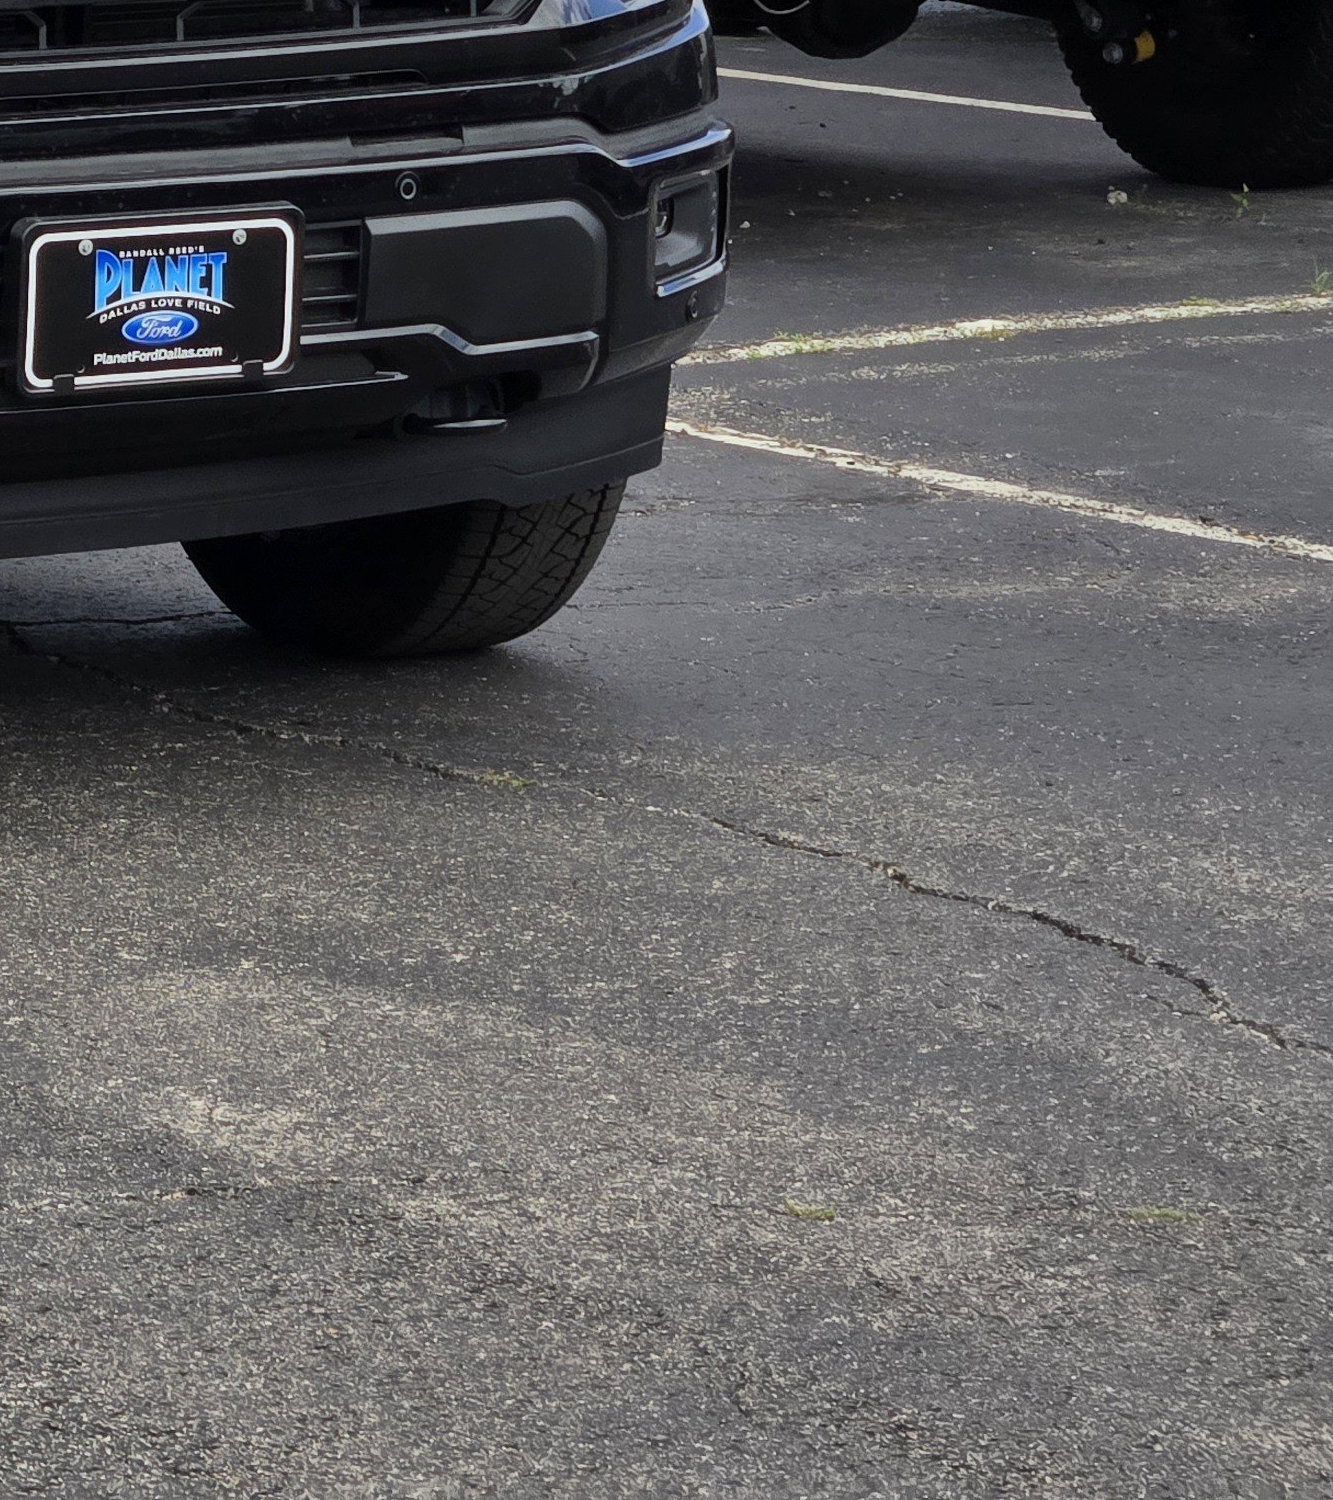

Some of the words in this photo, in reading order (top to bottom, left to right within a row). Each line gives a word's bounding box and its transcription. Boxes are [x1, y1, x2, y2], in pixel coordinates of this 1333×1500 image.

[95, 249, 228, 312] PLANET
[99, 301, 146, 324] DALLAS
[151, 298, 183, 308] LOVE
[187, 300, 221, 315] FIELD
[136, 315, 183, 339] Ford
[93, 346, 223, 366] PlanetFordDallas.com
